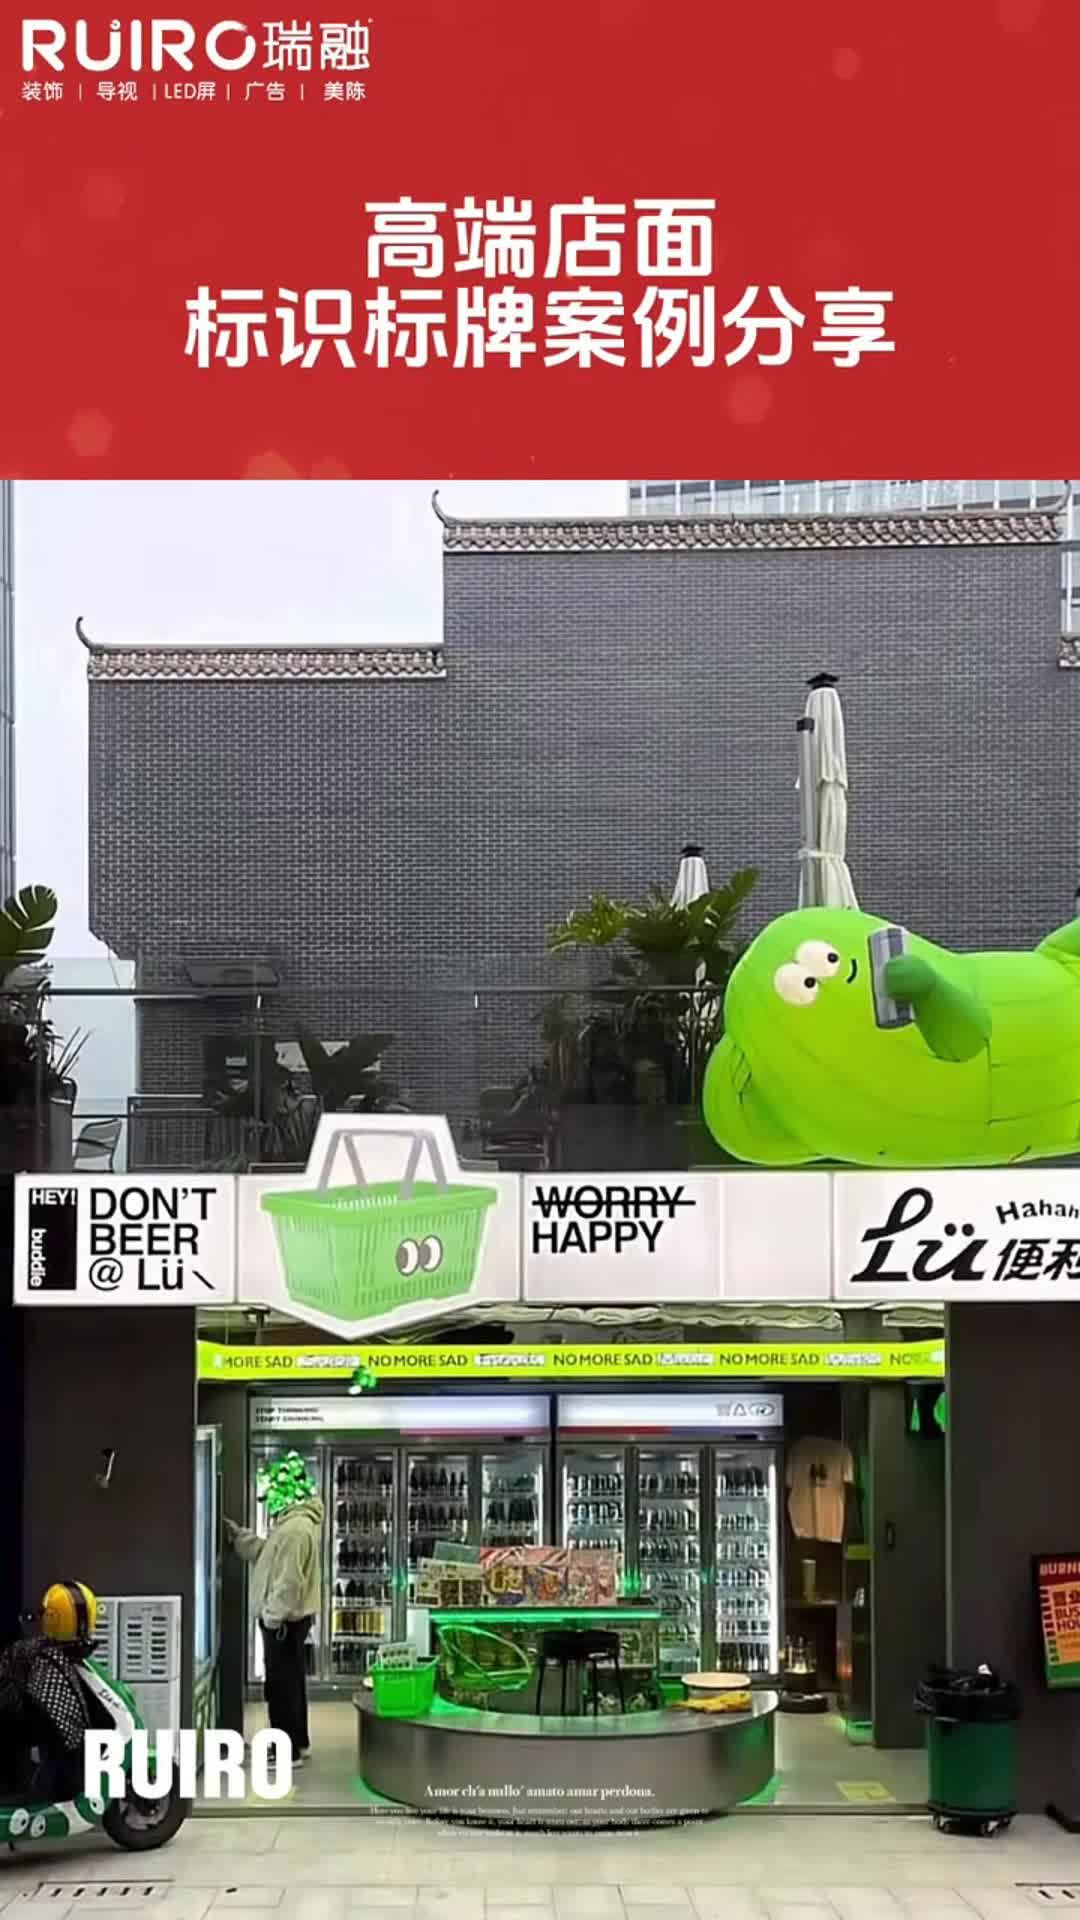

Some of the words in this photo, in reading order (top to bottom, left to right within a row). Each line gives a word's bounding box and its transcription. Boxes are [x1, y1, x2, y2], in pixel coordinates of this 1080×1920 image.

[32, 1189, 76, 1206] HEY!
[90, 1187, 216, 1220] DON’T
[532, 1185, 696, 1219] WORRY
[90, 1223, 199, 1256] BEER
[532, 1220, 664, 1254] HAPPY
[89, 1257, 123, 1291] @
[138, 1258, 183, 1290] Lü
[265, 1355, 293, 1368] SAD
[368, 1355, 391, 1367] NO
[391, 1355, 436, 1367] MORE
[439, 1355, 468, 1367] SAD
[553, 1354, 577, 1366] NO
[579, 1354, 619, 1366] MORE
[623, 1354, 653, 1366] SAD
[719, 1353, 744, 1366] NO
[745, 1353, 785, 1366] MORE
[790, 1353, 820, 1366] SAD
